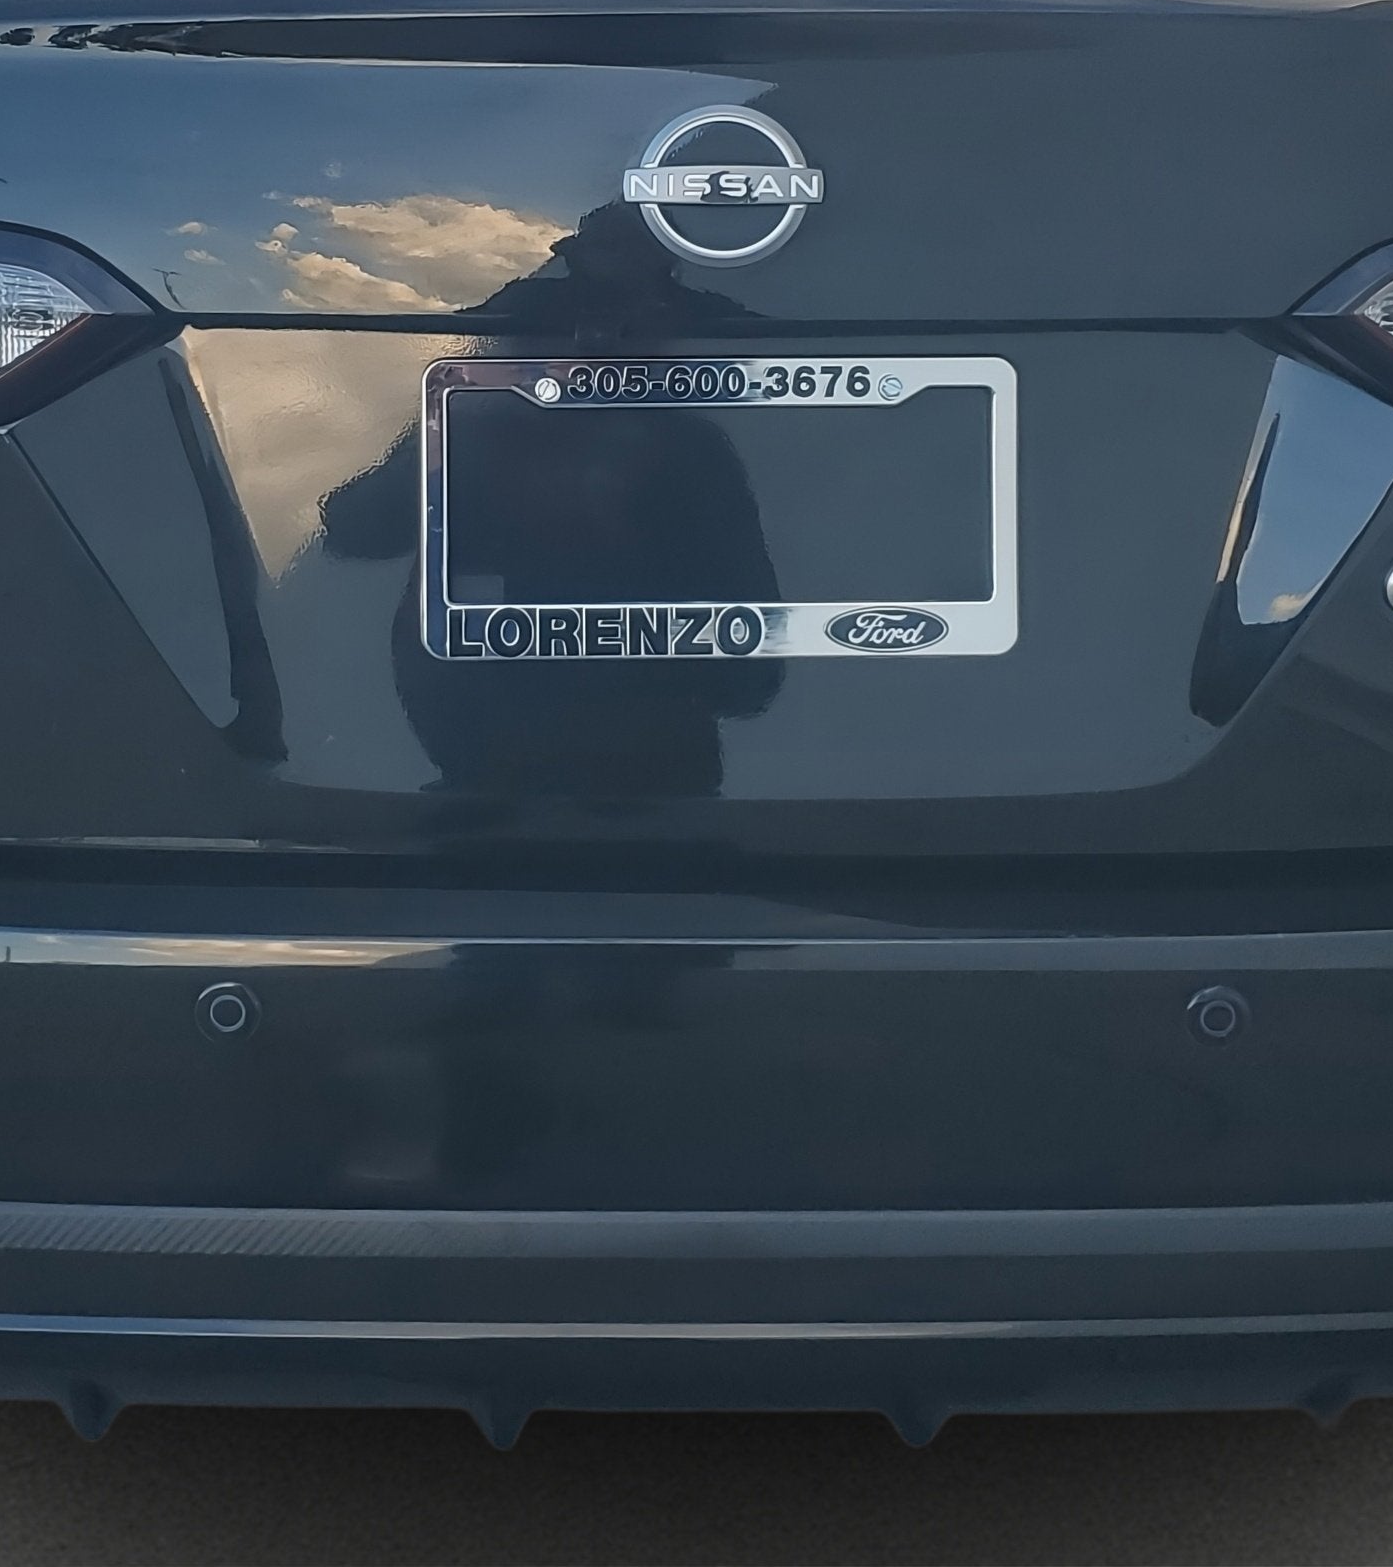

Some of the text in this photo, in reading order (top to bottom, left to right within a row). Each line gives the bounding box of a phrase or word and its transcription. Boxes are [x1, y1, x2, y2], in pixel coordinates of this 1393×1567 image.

[629, 174, 819, 198] NISSAN
[567, 365, 872, 398] 305-600-3676
[447, 606, 925, 657] LORENZO Ford
